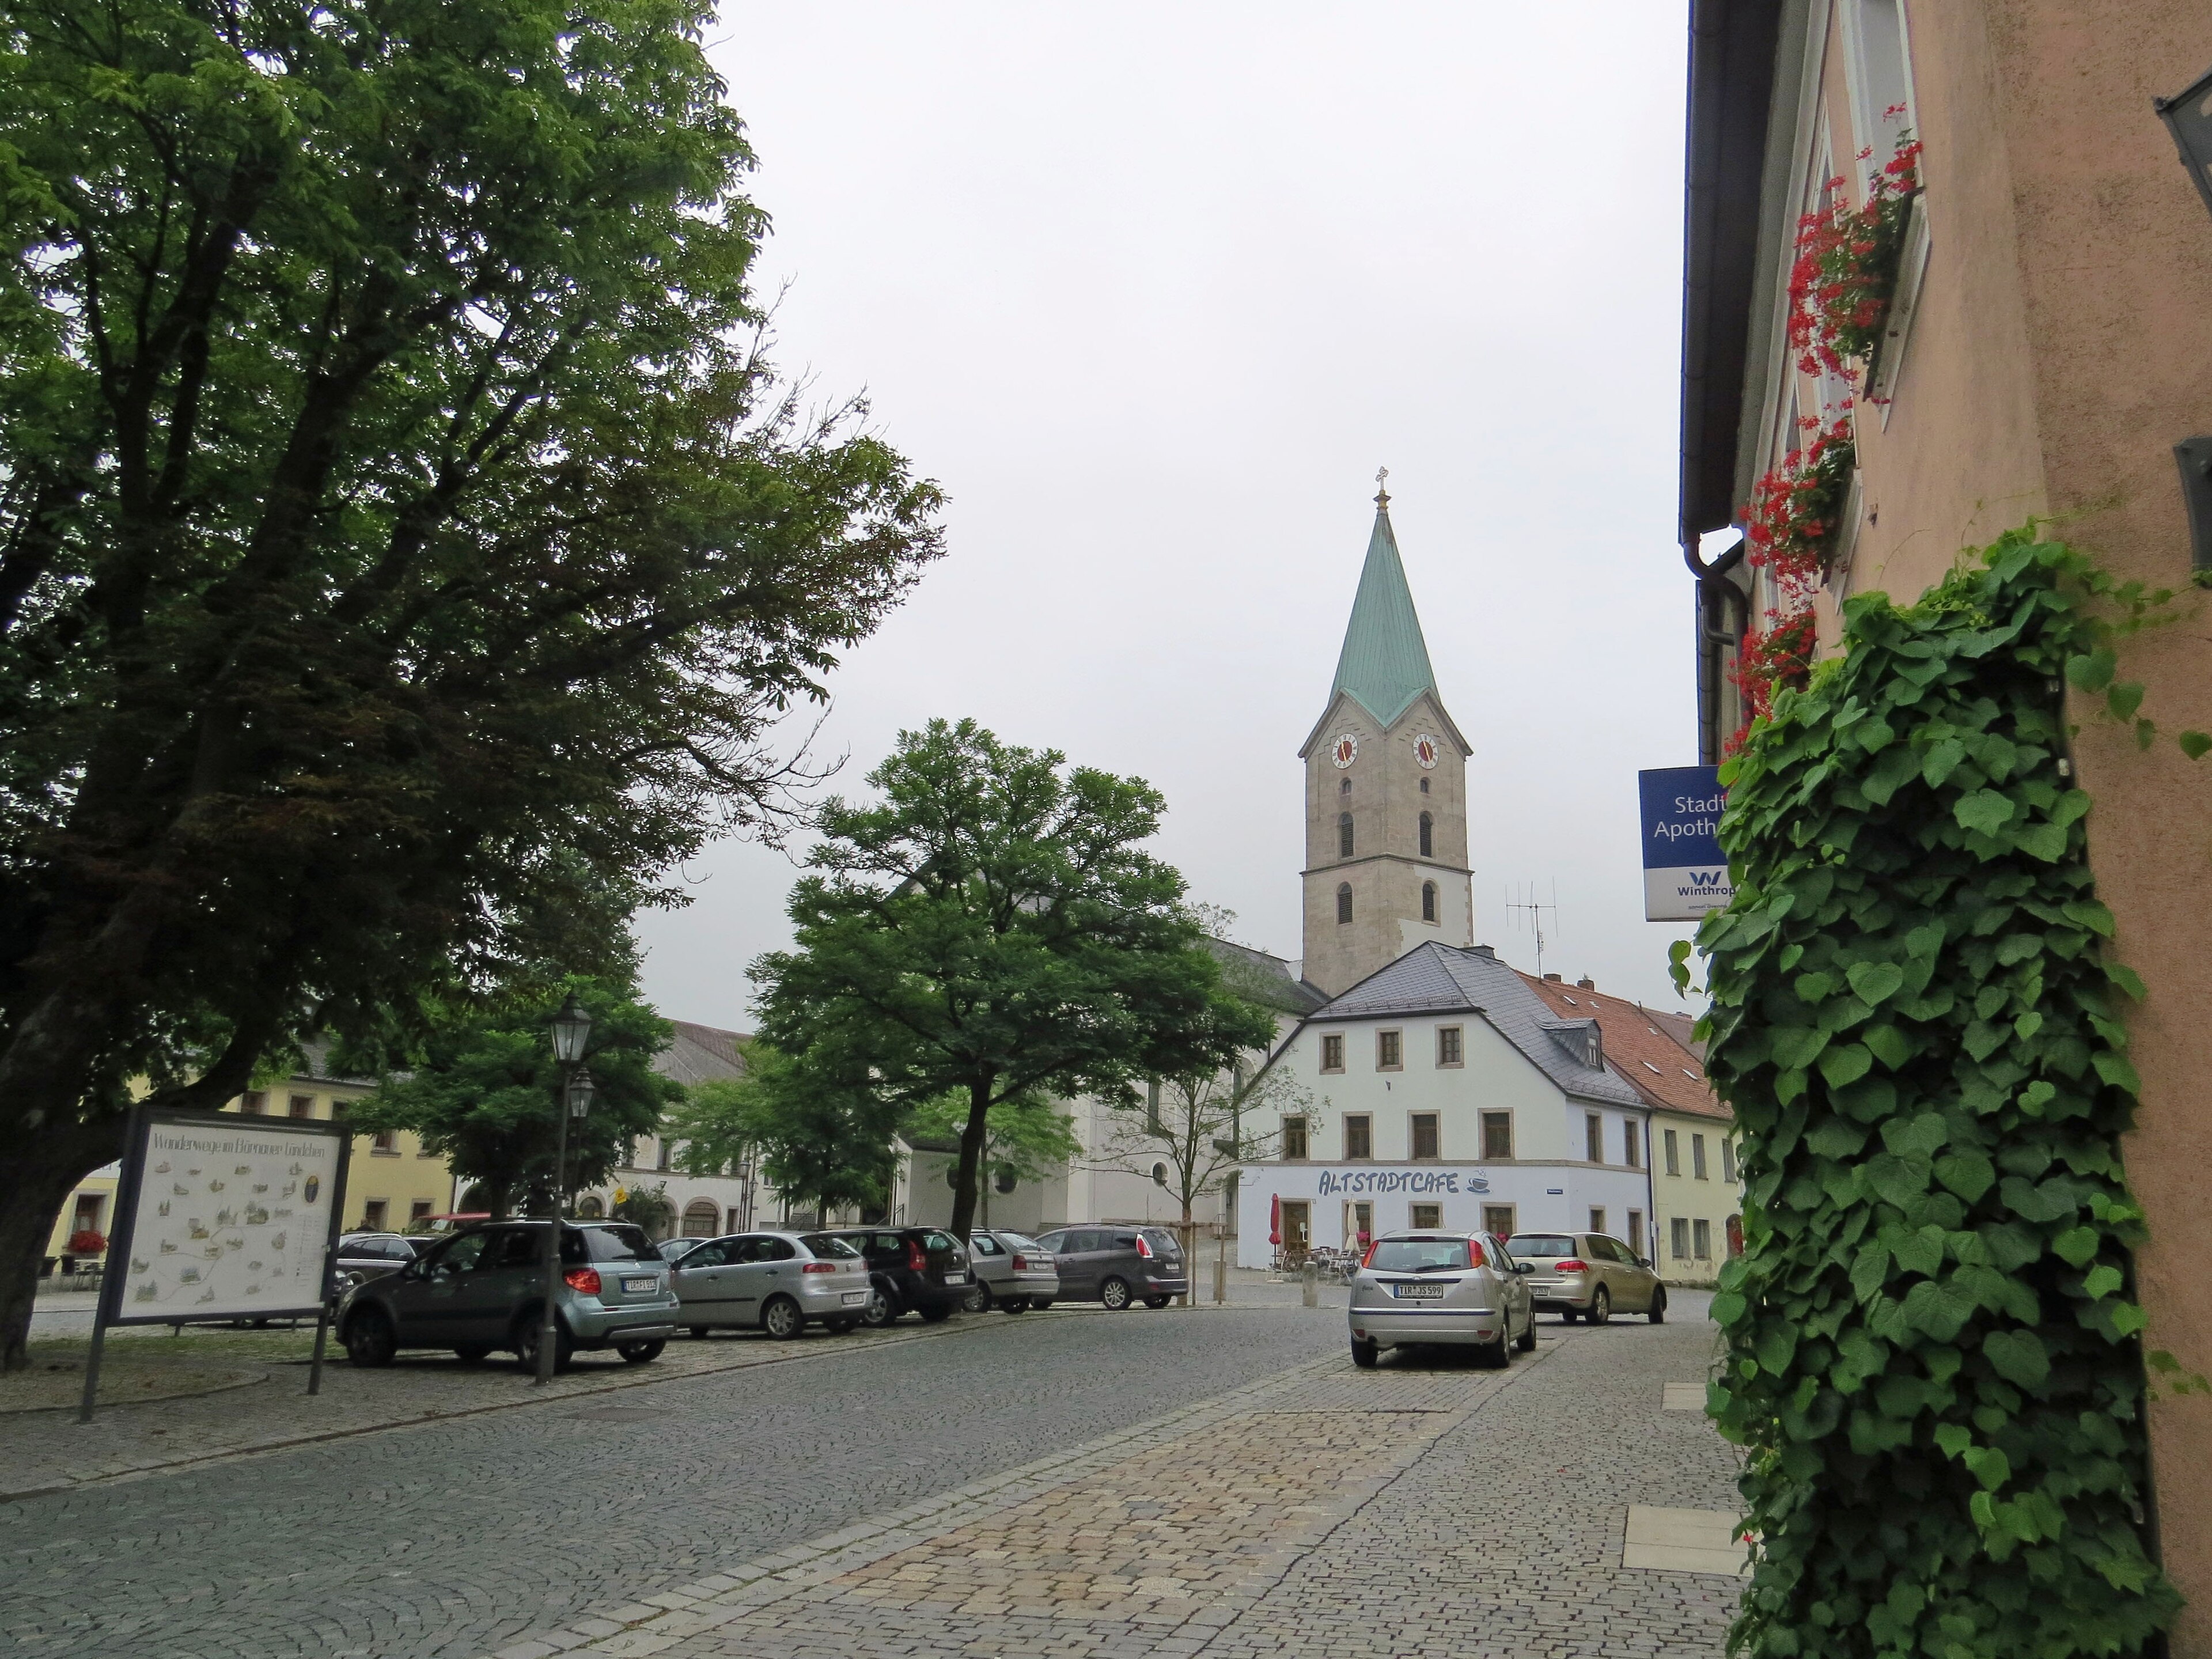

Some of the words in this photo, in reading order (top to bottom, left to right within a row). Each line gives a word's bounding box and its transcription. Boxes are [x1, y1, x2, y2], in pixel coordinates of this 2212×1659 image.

[1675, 794, 1728, 813] Stadt
[1654, 817, 1717, 842] Apoth
[1677, 886, 1736, 897] Winthrop
[1319, 1170, 1460, 1196] ALTSTADTCAFE
[1400, 1286, 1412, 1294] TIR
[1418, 1286, 1427, 1294] JS
[1427, 1286, 1441, 1294] 599
